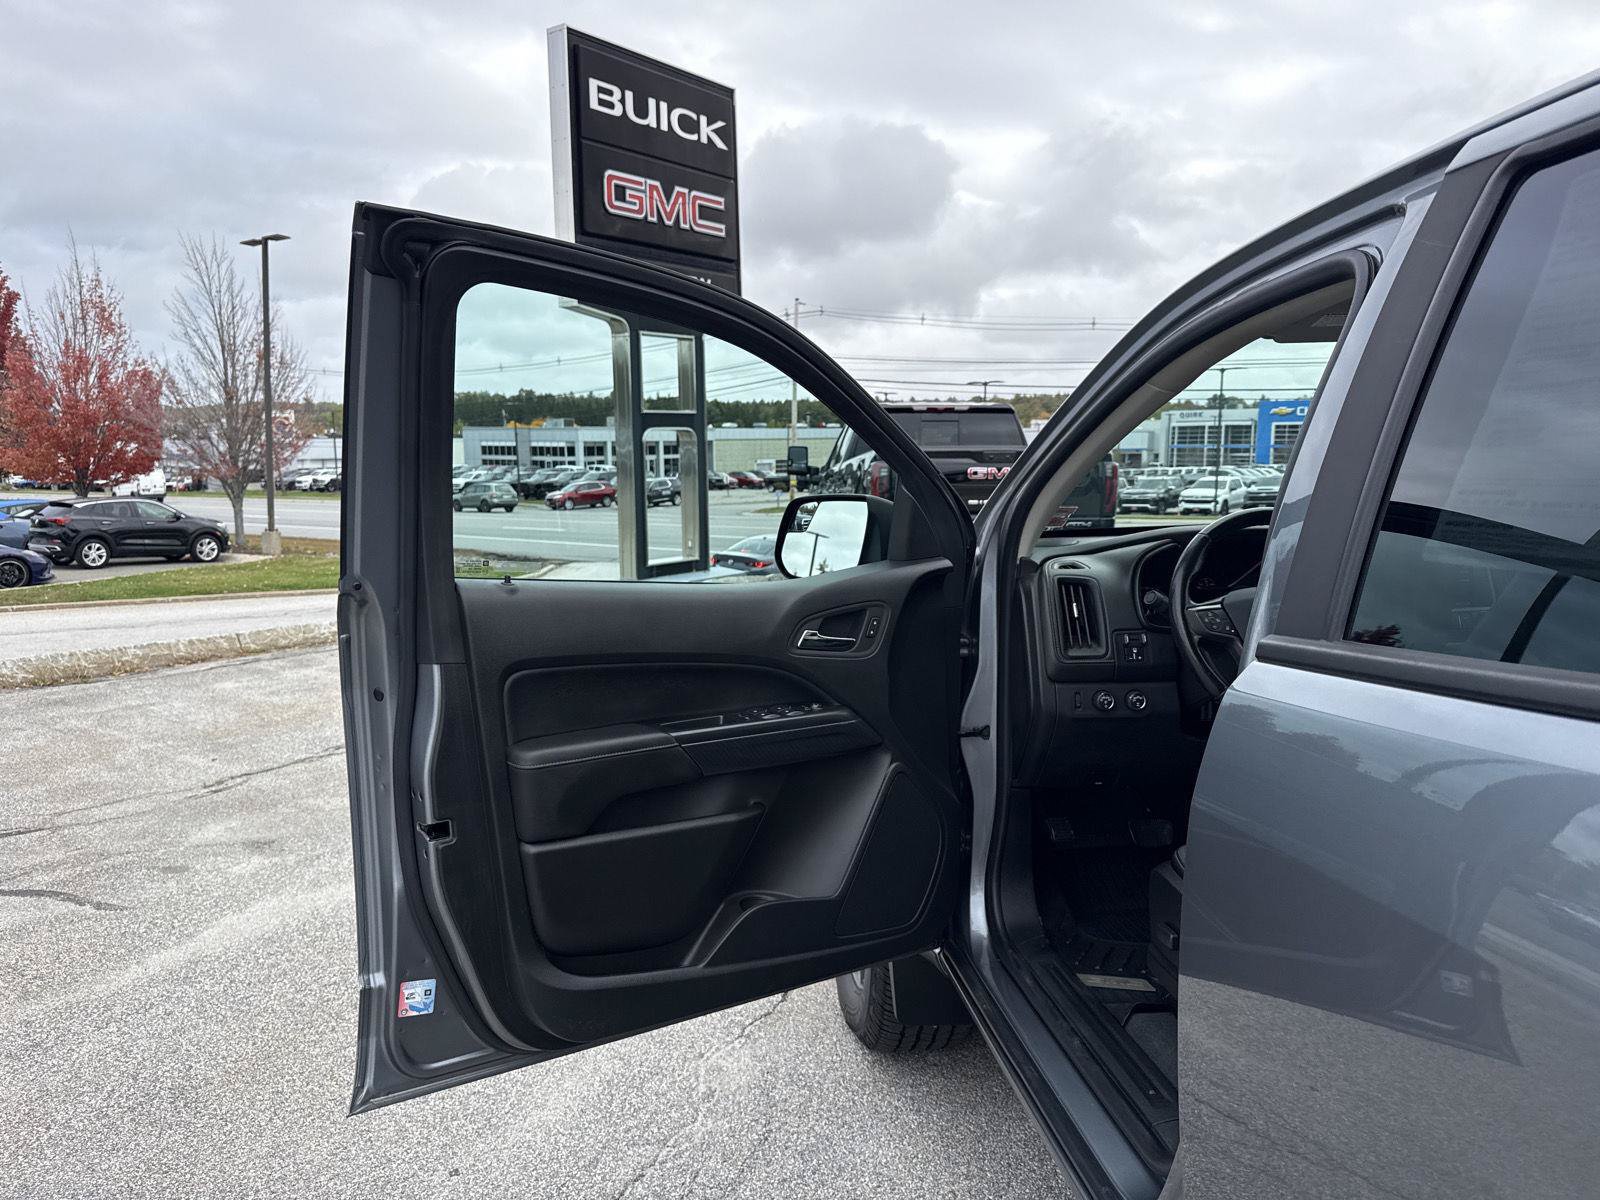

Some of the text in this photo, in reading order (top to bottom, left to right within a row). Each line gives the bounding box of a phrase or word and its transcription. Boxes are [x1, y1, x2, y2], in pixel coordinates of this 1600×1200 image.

[589, 77, 728, 151] BUICK
[604, 168, 726, 237] GMC
[967, 466, 1010, 480] GM
